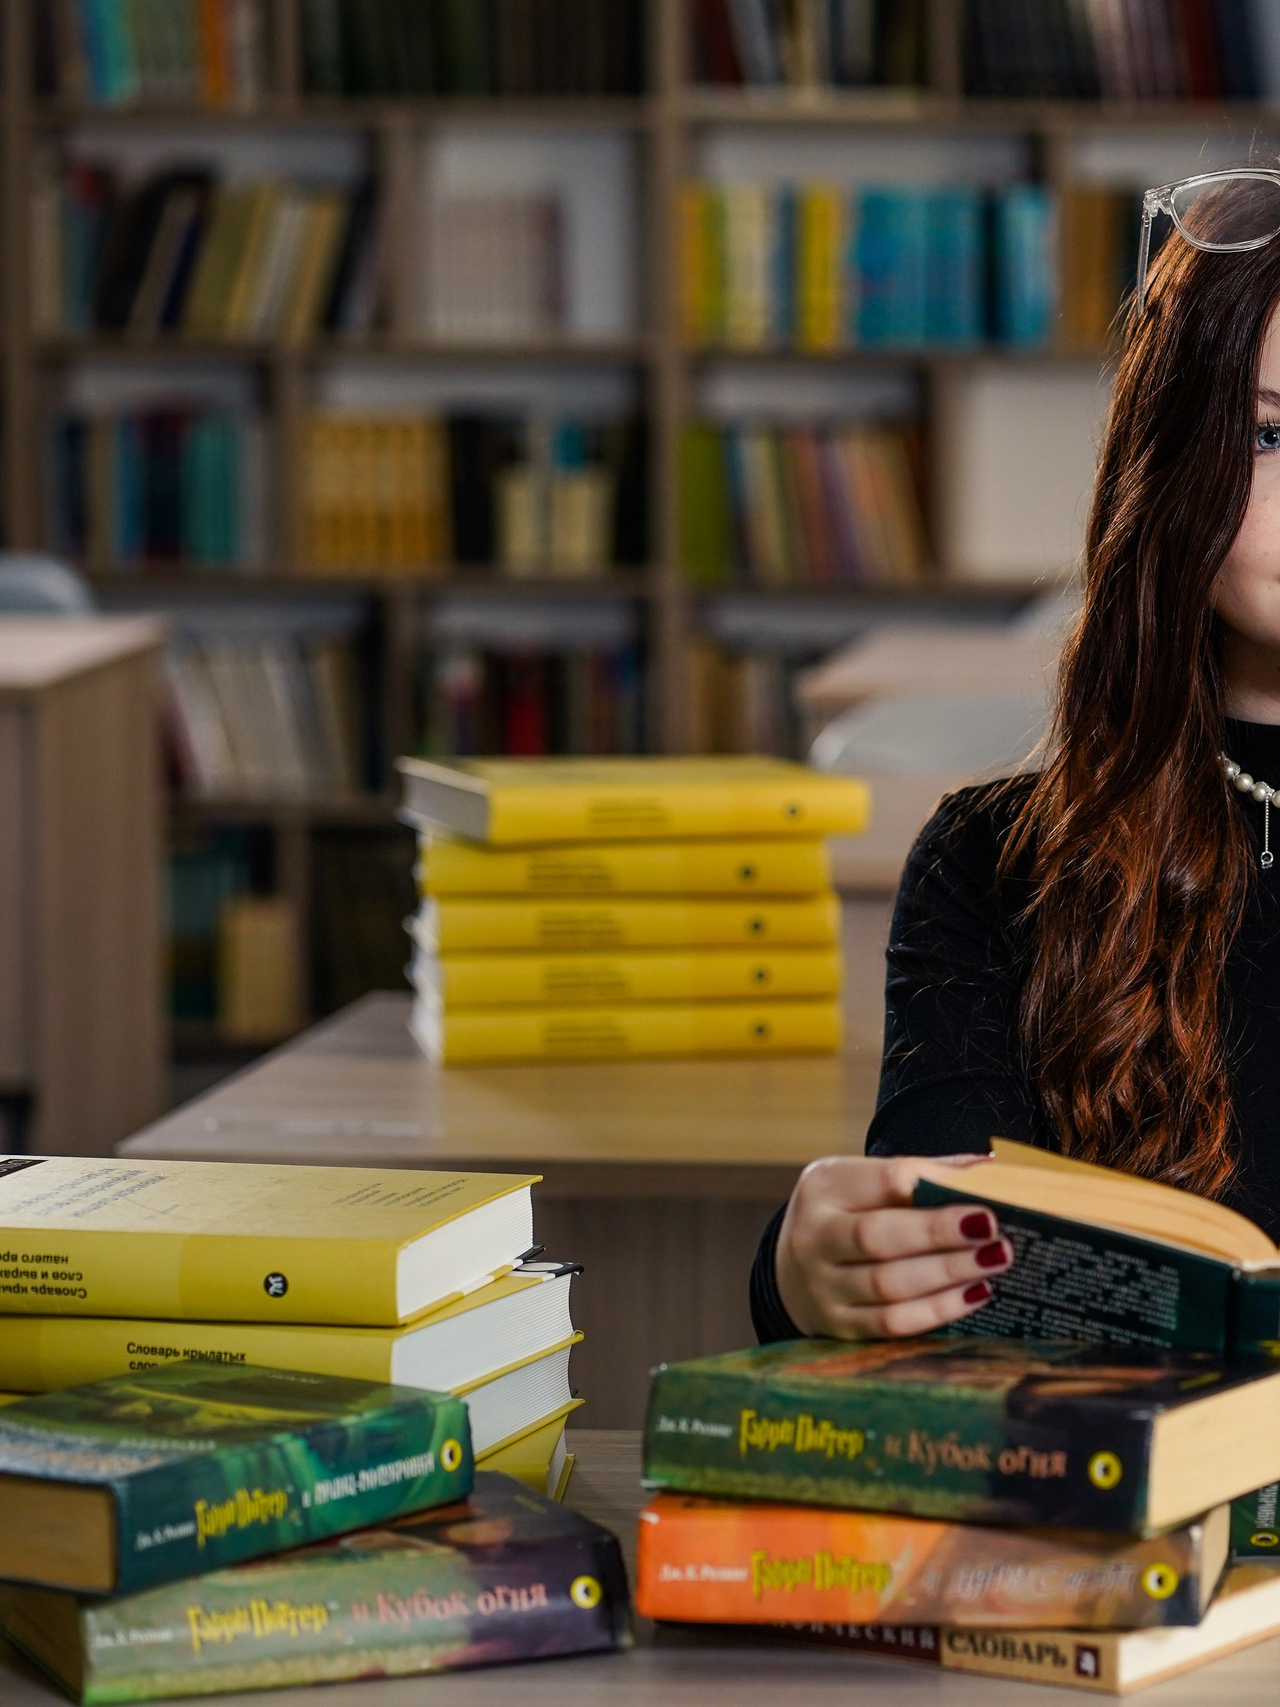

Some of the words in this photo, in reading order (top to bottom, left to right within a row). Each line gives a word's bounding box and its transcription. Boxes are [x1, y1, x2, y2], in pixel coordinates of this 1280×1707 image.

[20, 1254, 69, 1265] нашего
[40, 1271, 49, 1280] и
[52, 1271, 83, 1281] слов
[30, 1285, 88, 1299] Словарь
[127, 1342, 180, 1359] Словарь
[945, 1630, 1068, 1668] СЛОВАРЬ
